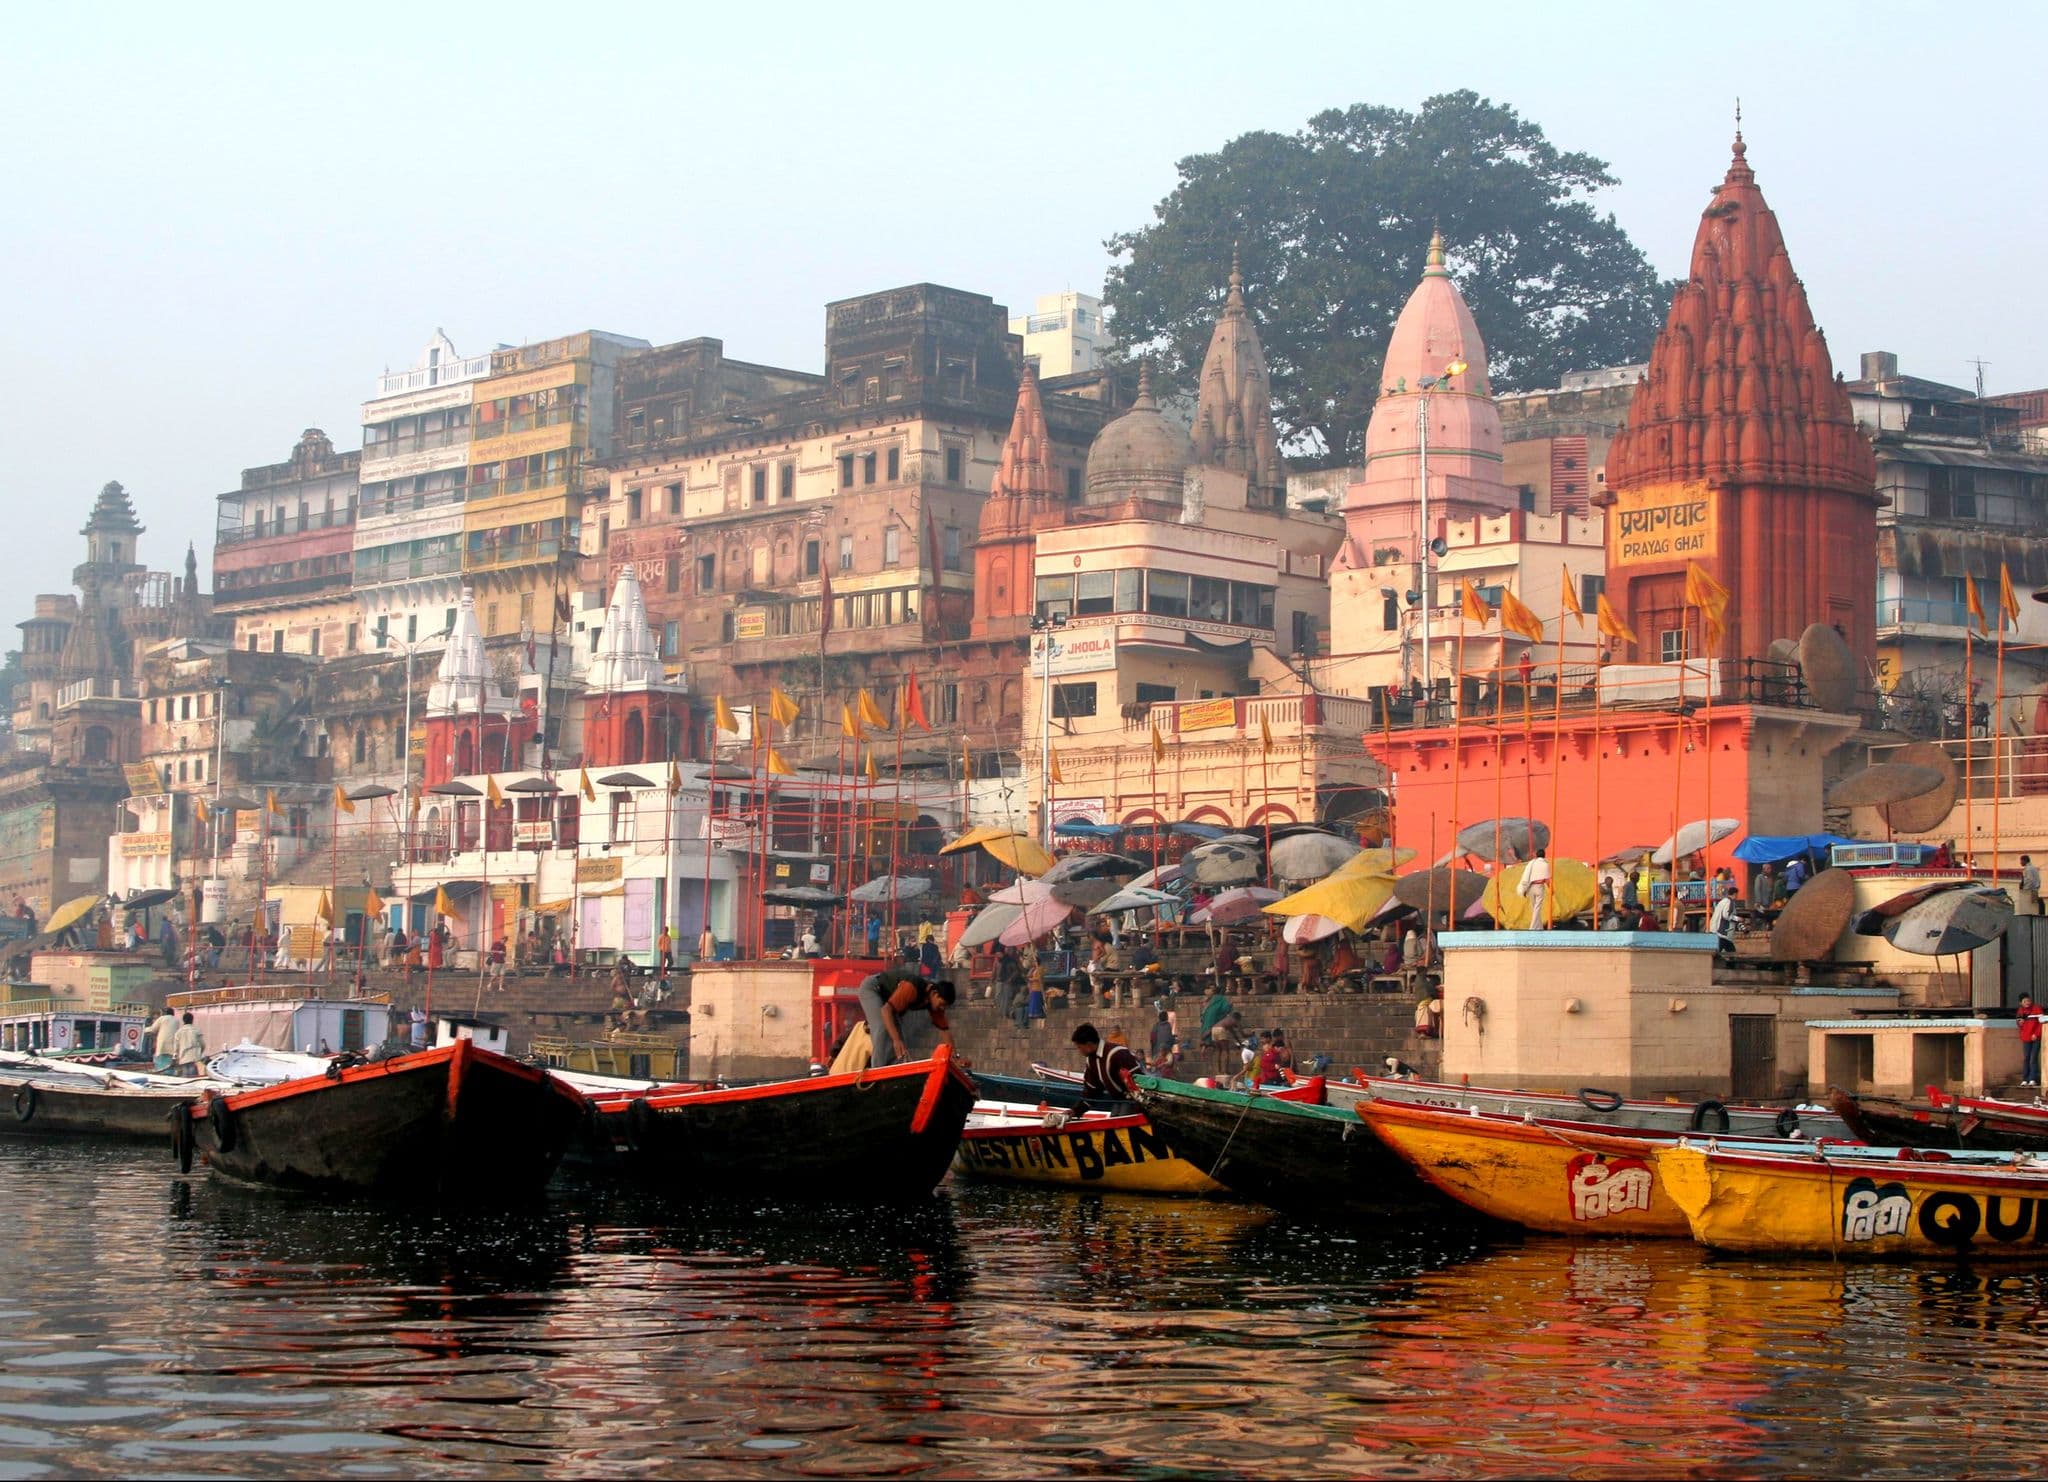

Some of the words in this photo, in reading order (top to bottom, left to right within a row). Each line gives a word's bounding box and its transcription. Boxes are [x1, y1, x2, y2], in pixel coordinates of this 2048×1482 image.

[1623, 539, 1669, 558] PRAYAG
[1674, 533, 1705, 552] GHAT
[1067, 639, 1111, 654] JHOOLA
[1918, 1191, 2048, 1247] QU
